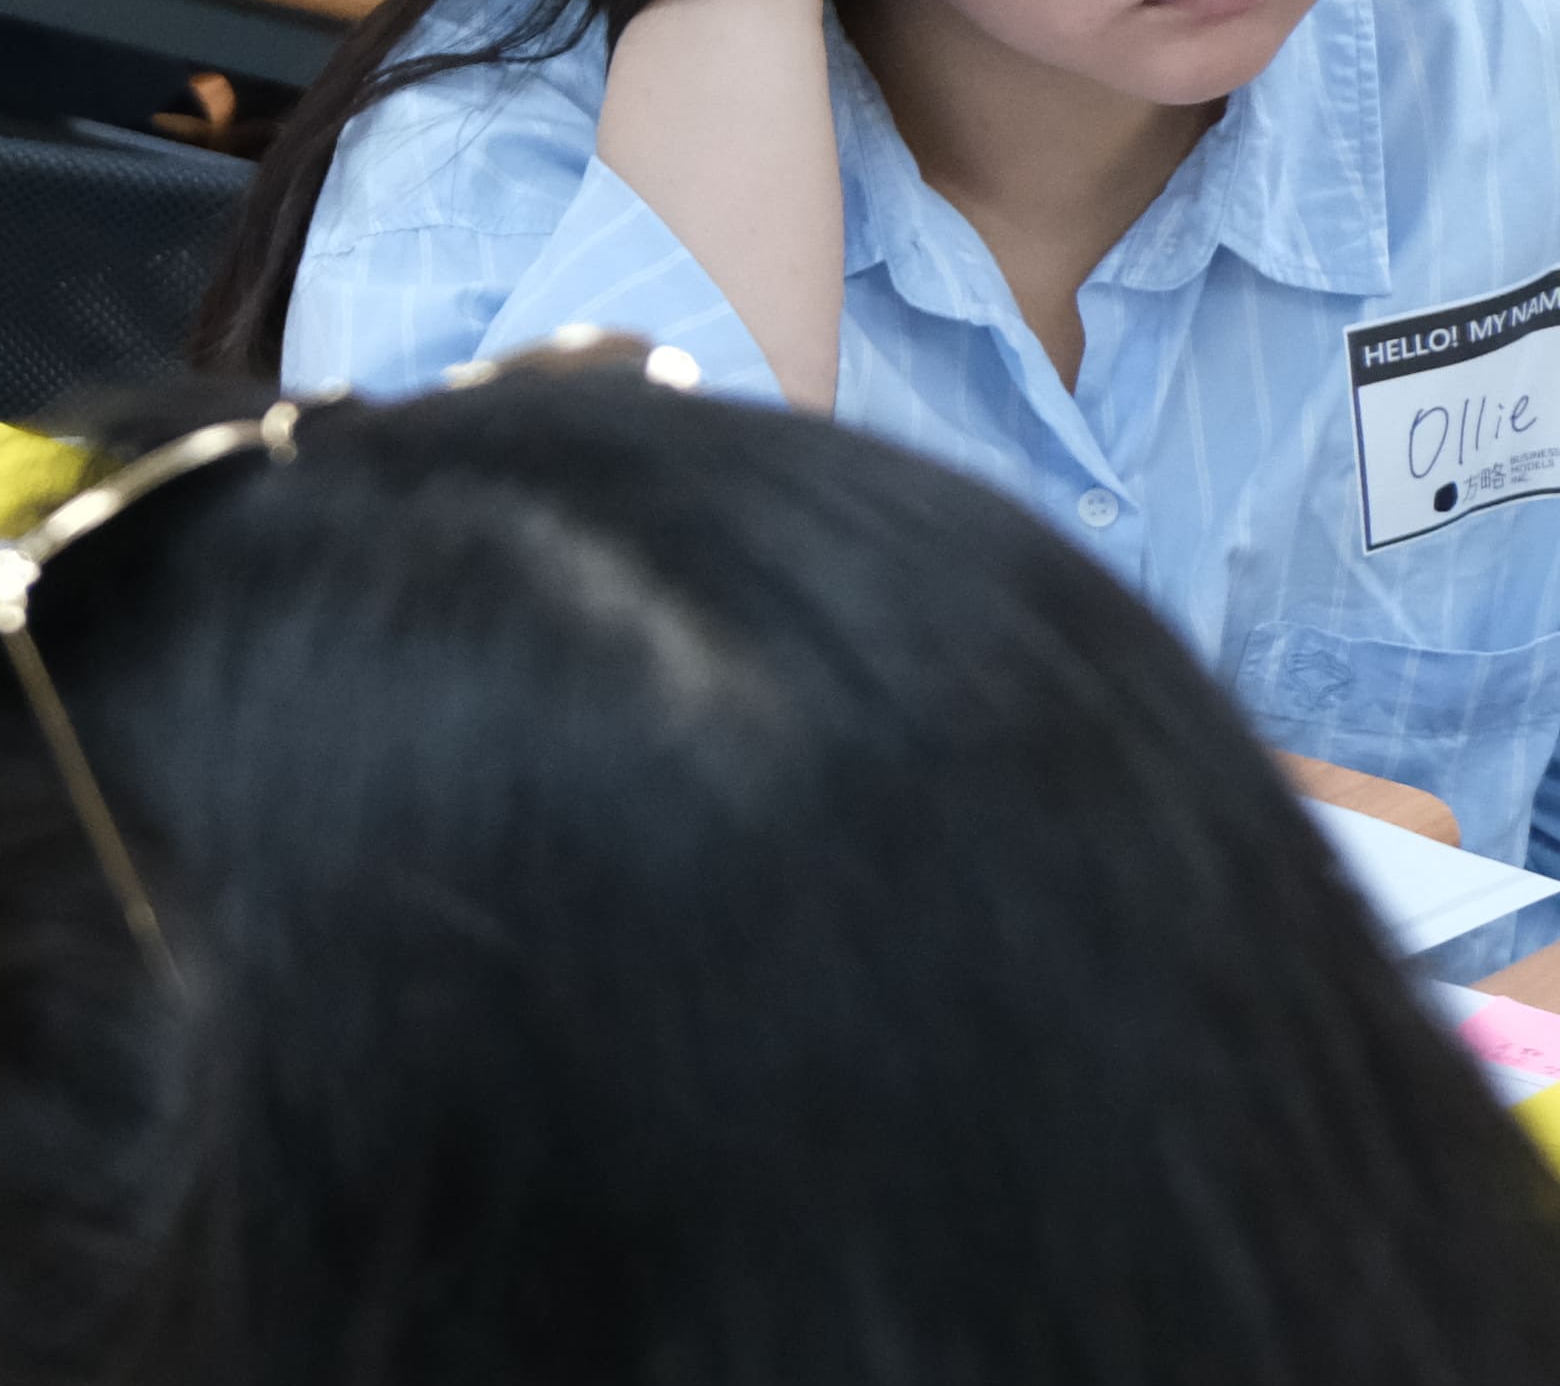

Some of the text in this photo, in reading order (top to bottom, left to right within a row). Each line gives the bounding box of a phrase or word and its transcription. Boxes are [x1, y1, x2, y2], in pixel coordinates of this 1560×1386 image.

[1364, 325, 1460, 368] HELLO!
[1470, 310, 1507, 343] MY
[1408, 395, 1537, 479] Ollie
[1463, 462, 1507, 504] 方略
